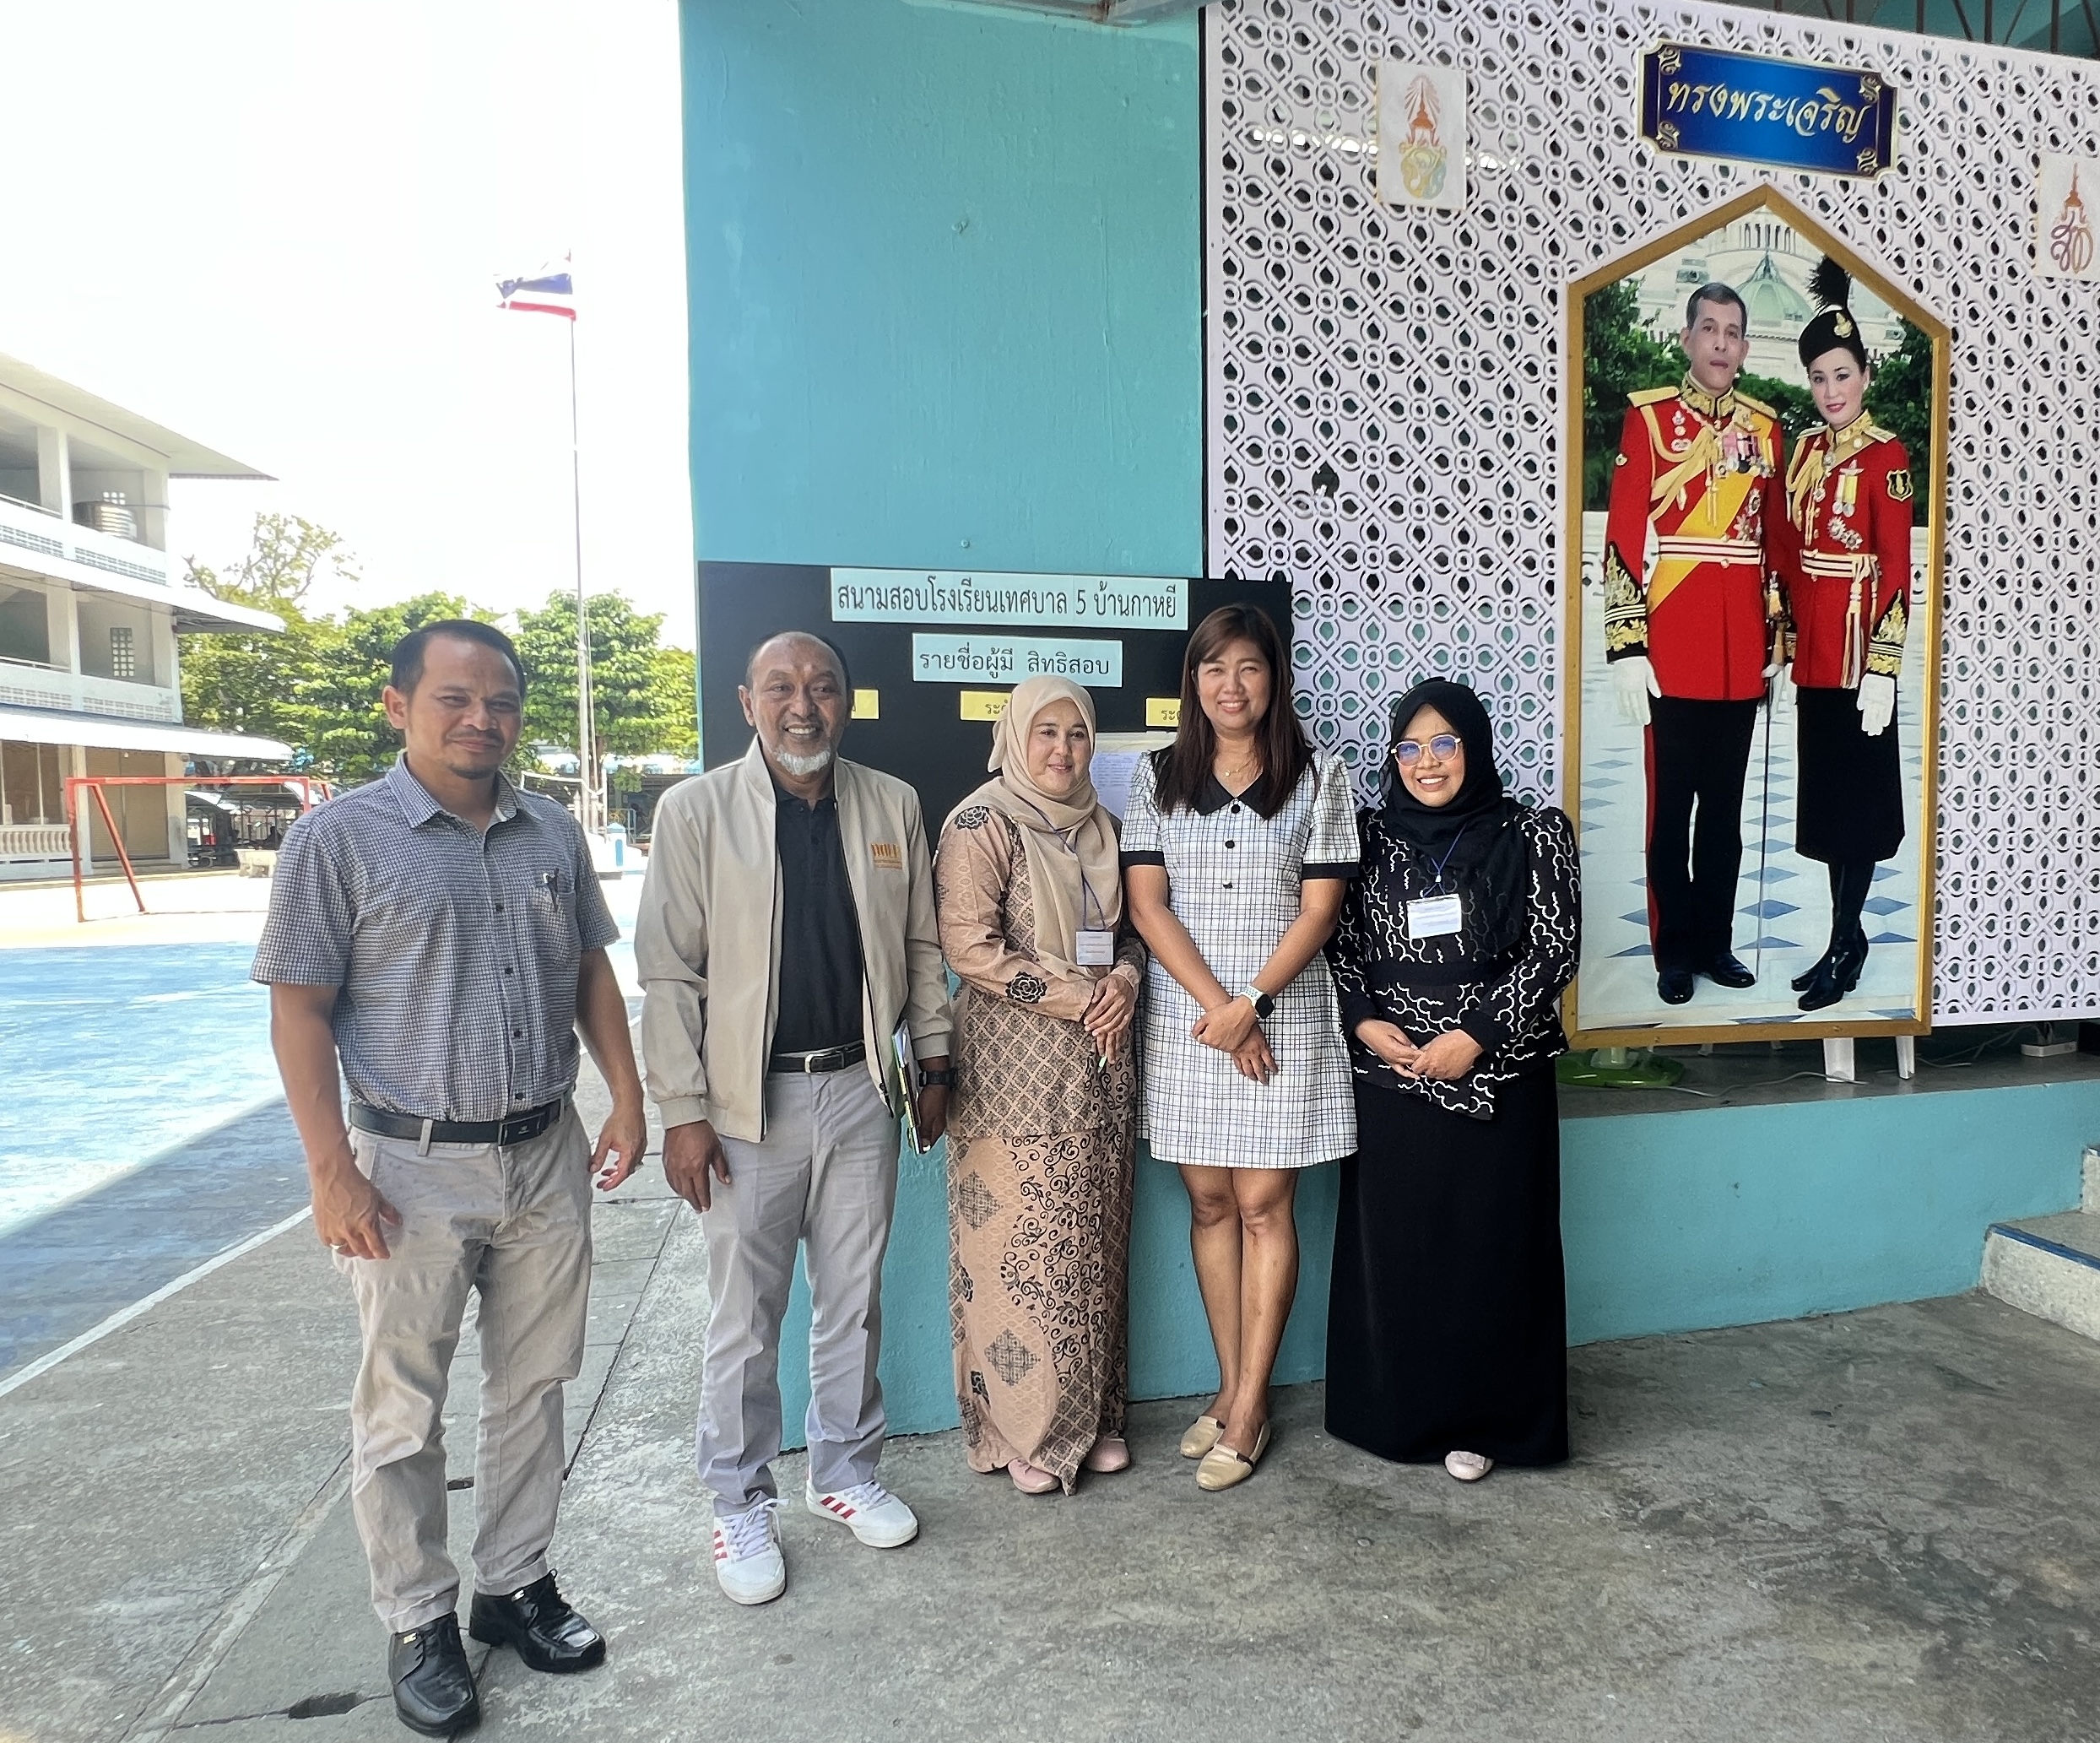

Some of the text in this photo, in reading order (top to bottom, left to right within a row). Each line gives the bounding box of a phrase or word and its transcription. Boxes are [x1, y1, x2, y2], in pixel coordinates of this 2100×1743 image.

[1667, 81, 1873, 143] ทรงพระเจริญ
[837, 575, 1177, 618] สนามสอบโรงเรียนเทศบาล 5 บ้านกาหยี
[919, 641, 1110, 679] รายชื่อผู้มี สิทธิสอบ
